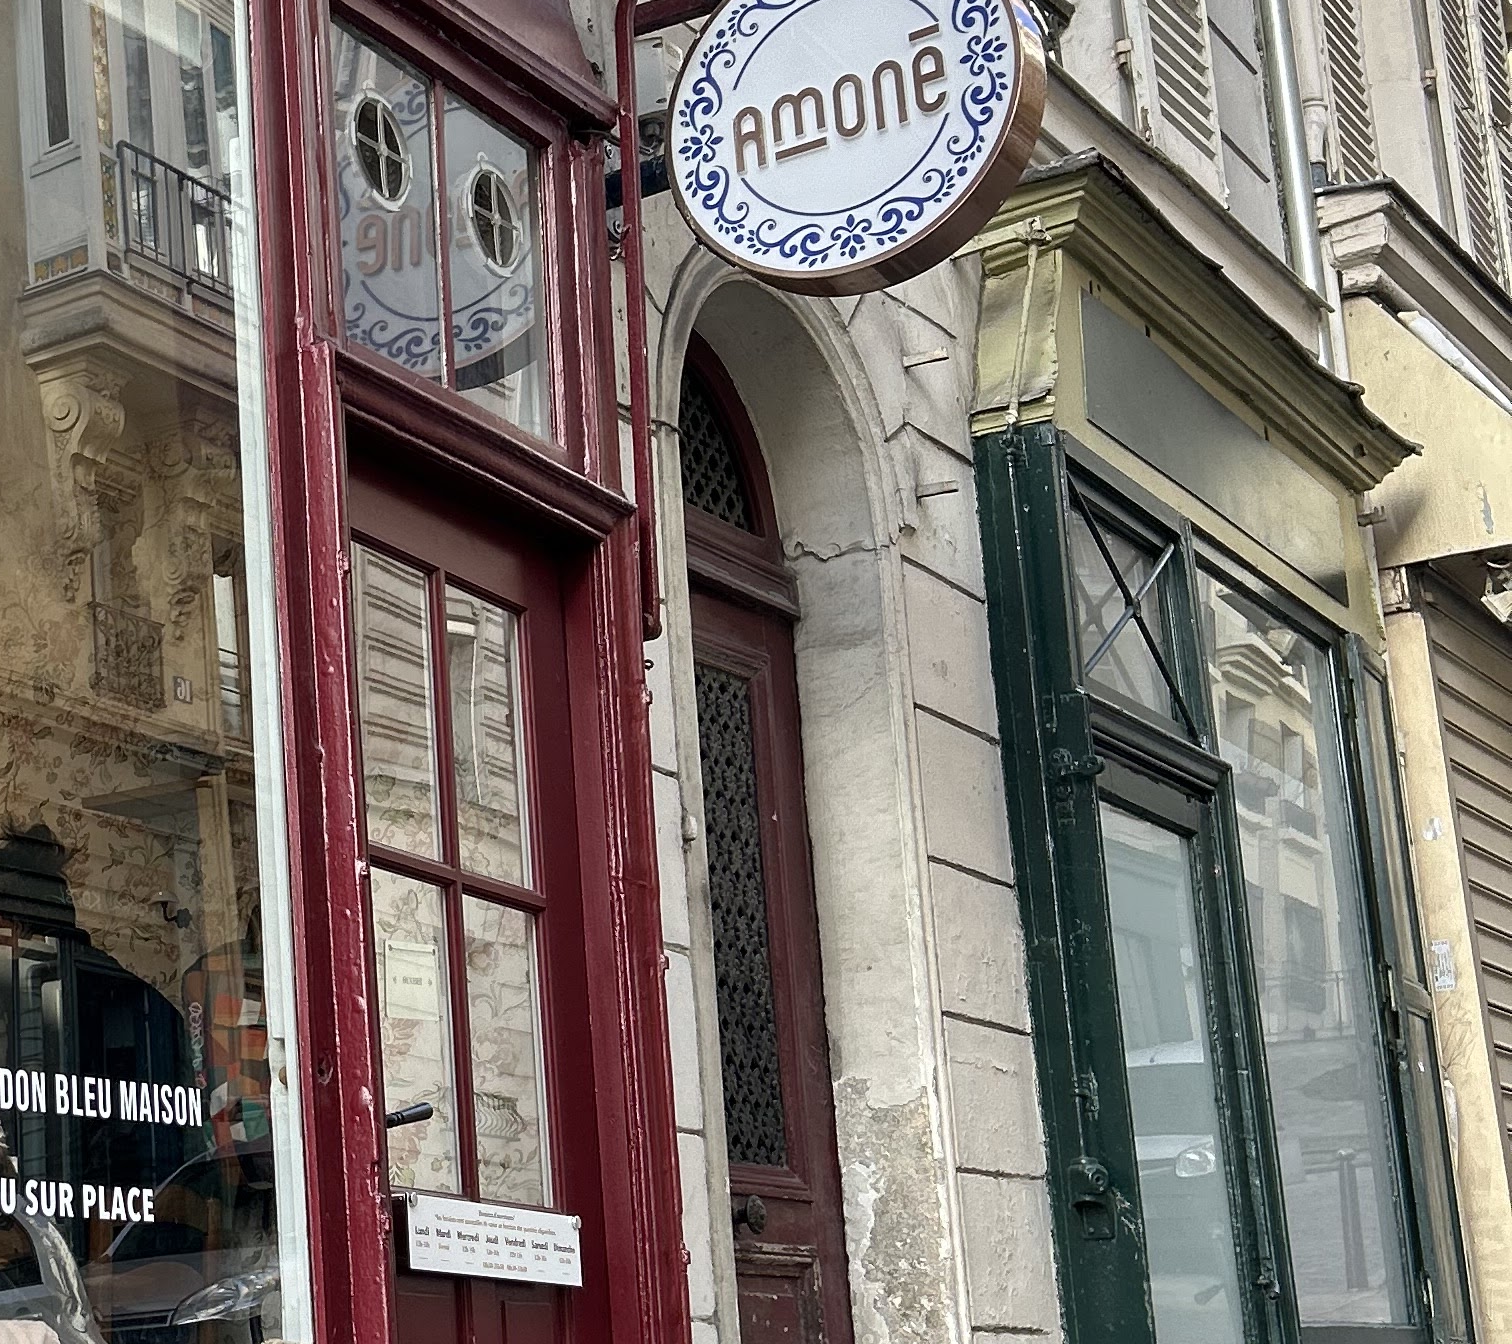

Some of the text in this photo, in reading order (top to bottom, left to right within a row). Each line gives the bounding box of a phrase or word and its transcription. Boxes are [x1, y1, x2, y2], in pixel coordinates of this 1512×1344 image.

[55, 1073, 112, 1119] BLEU
[120, 1080, 203, 1127] MAISON
[25, 1179, 75, 1218] SUR
[82, 1184, 156, 1223] PLACE
